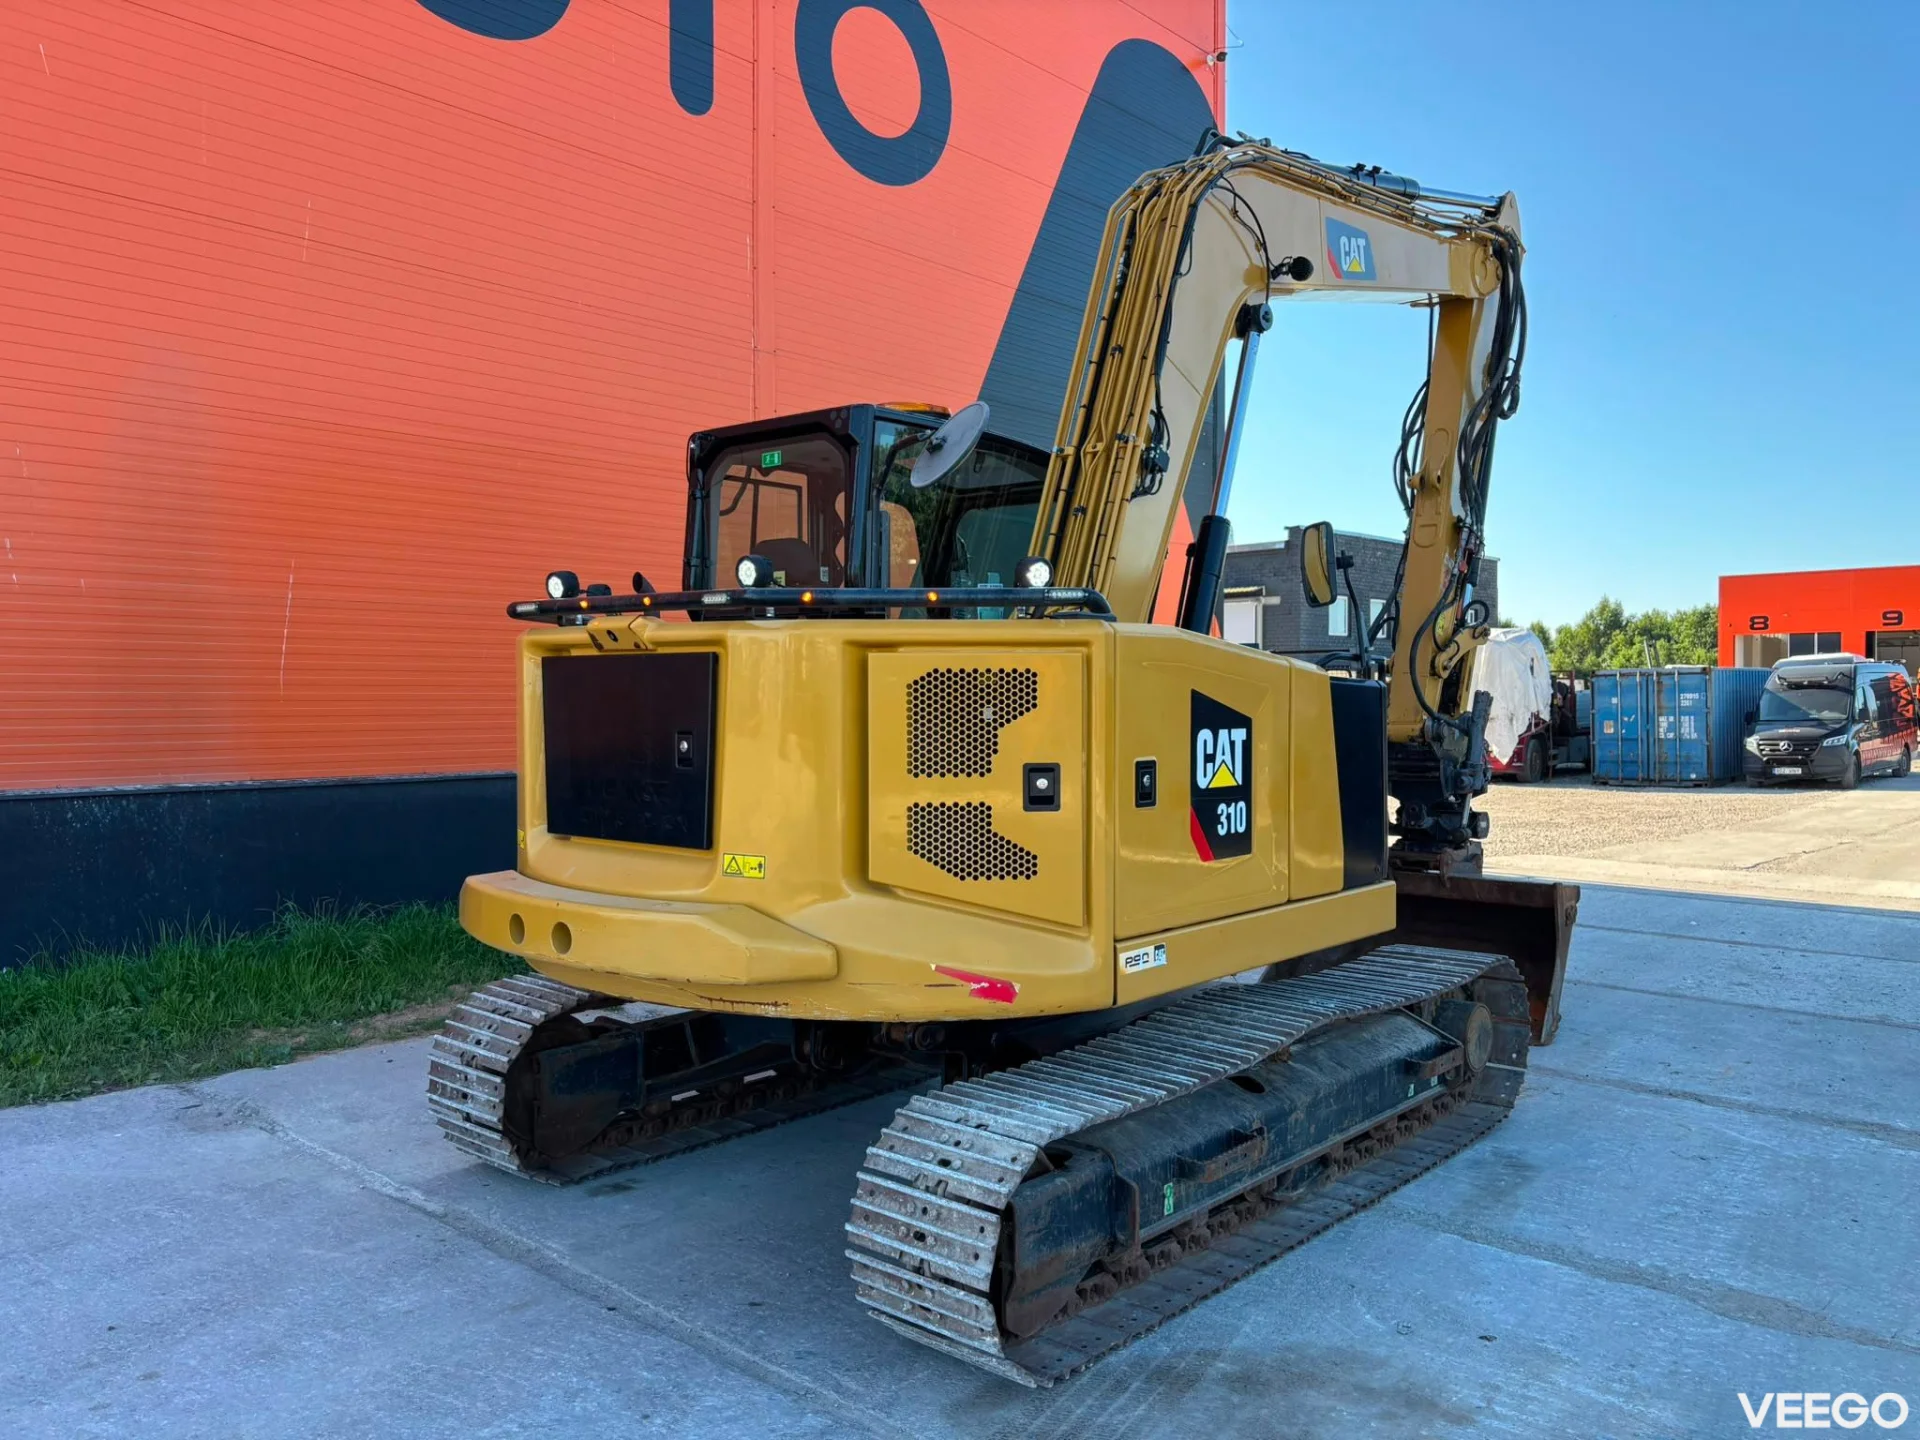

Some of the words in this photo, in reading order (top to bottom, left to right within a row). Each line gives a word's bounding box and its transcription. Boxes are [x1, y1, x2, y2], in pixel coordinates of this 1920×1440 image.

[1339, 235, 1366, 273] CAT
[1749, 615, 1769, 630] 8
[1882, 610, 1903, 626] 9
[1196, 727, 1247, 790] CAT
[1217, 800, 1247, 837] 310
